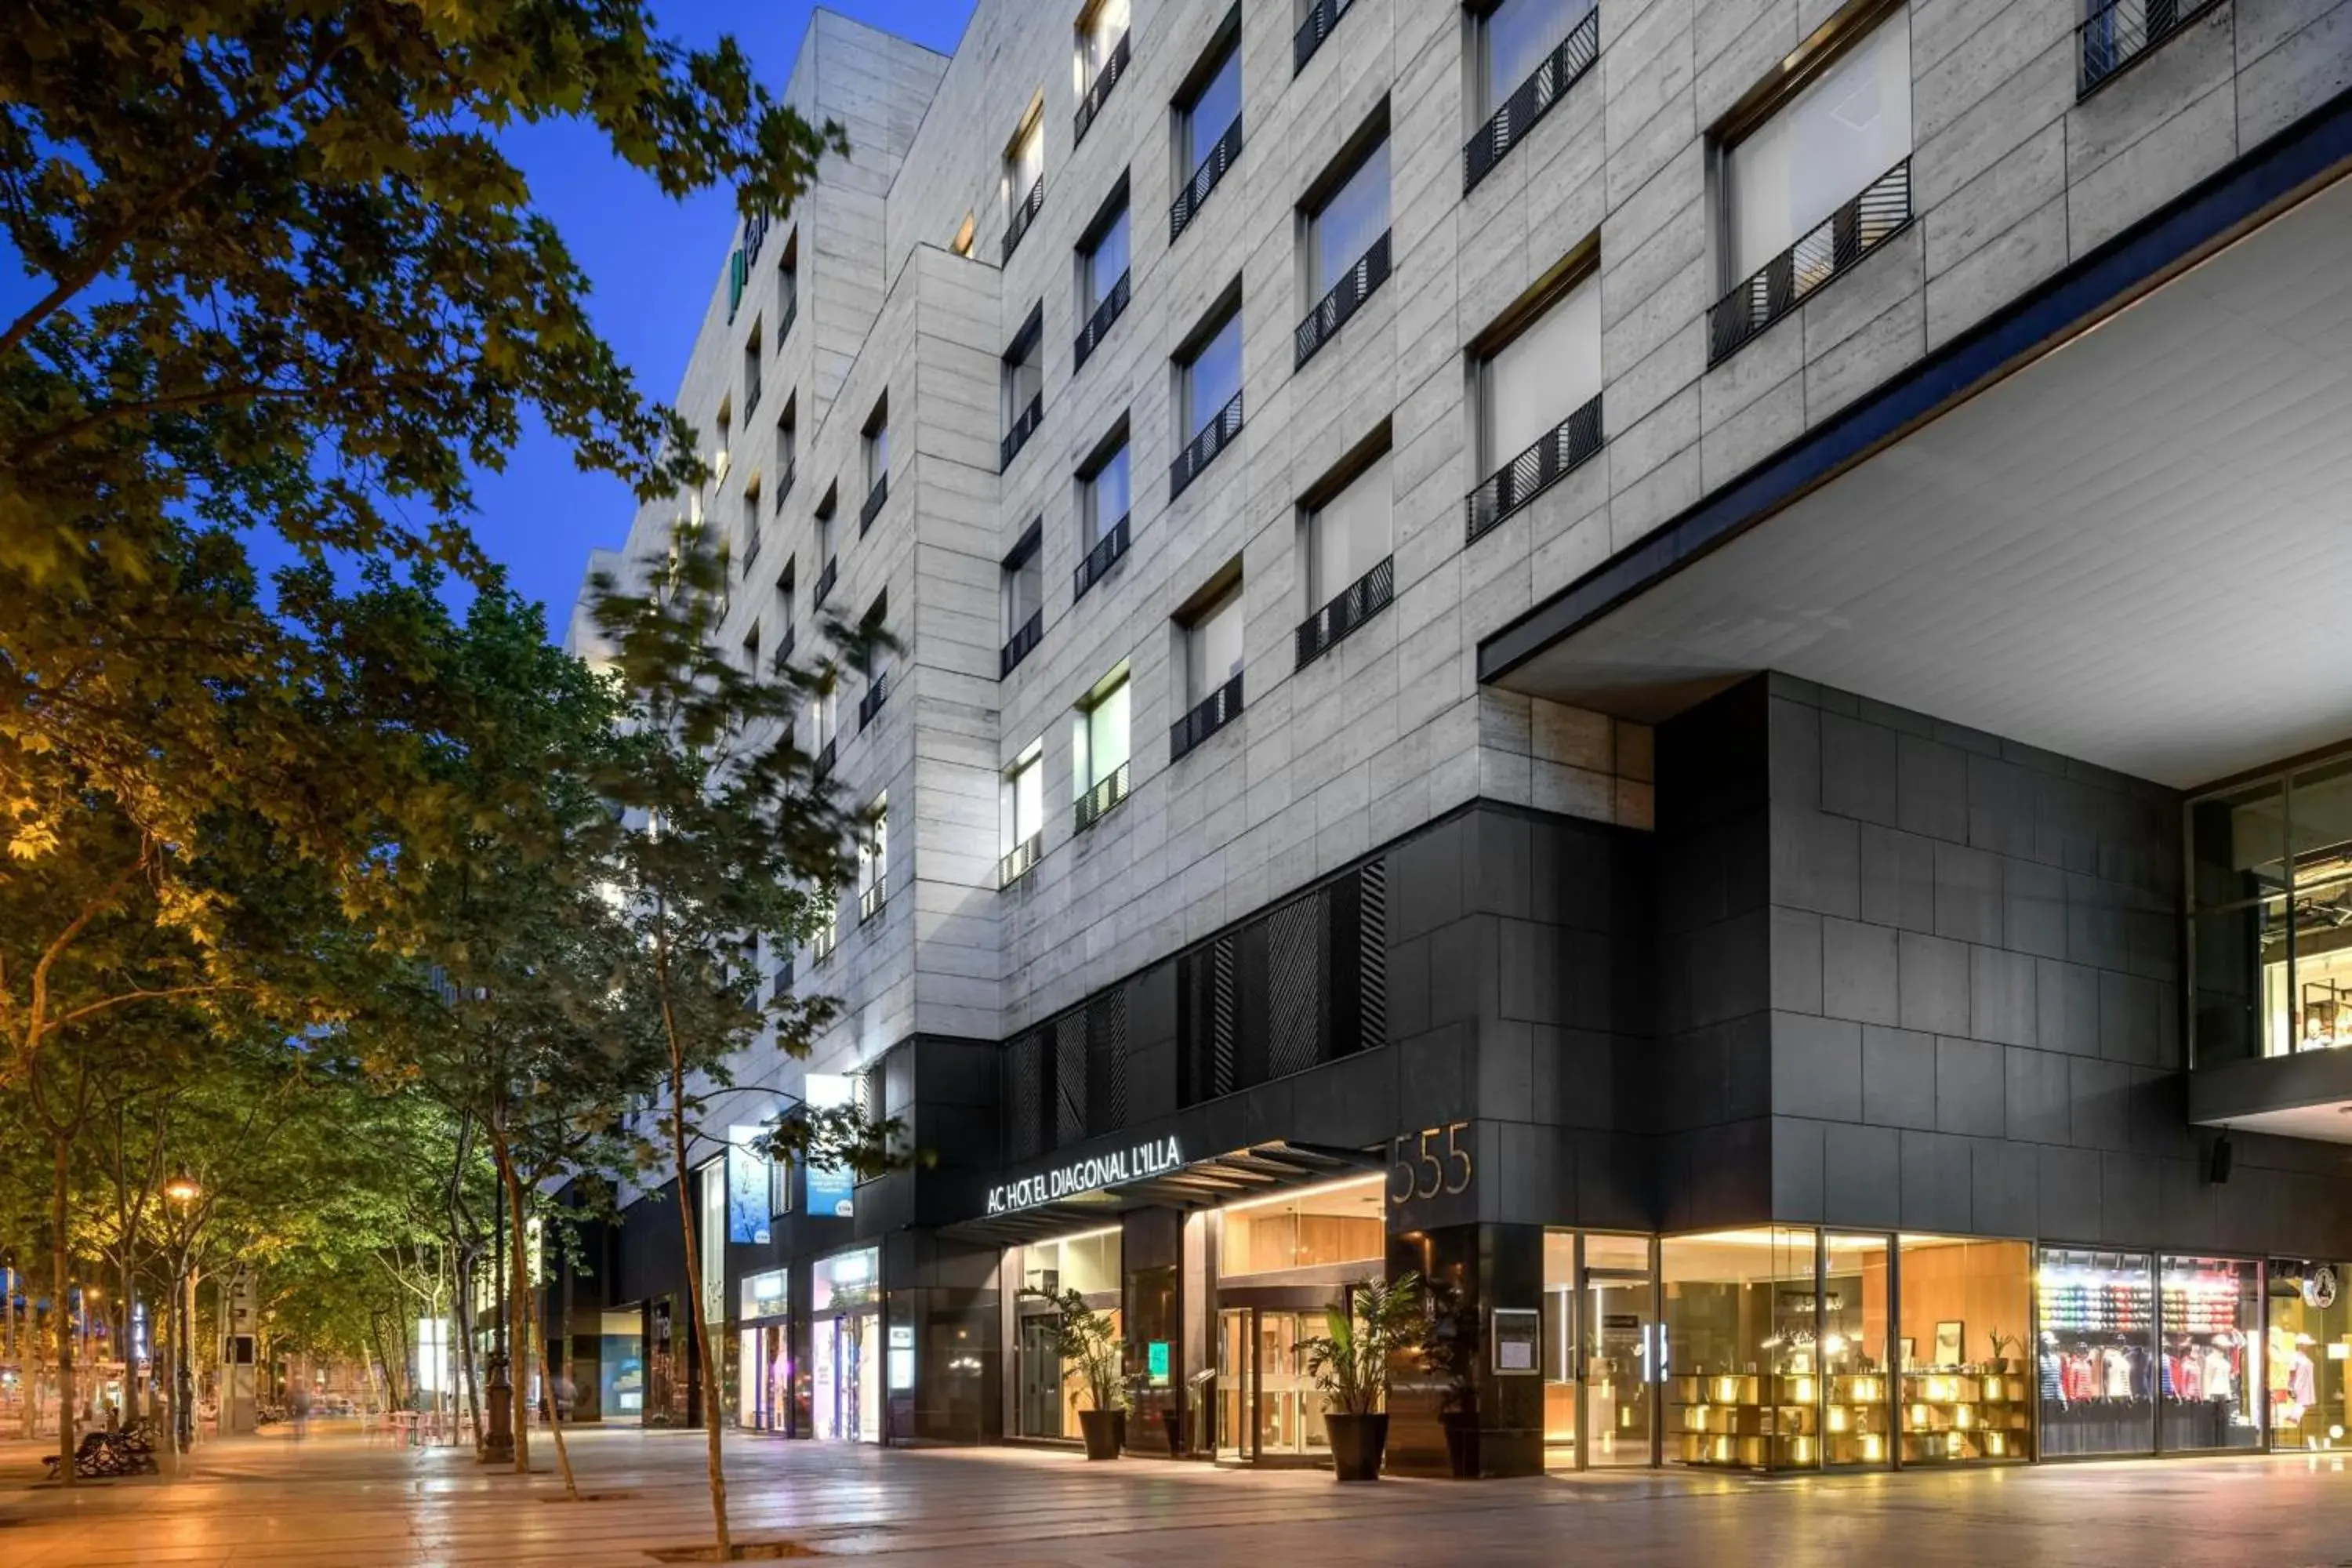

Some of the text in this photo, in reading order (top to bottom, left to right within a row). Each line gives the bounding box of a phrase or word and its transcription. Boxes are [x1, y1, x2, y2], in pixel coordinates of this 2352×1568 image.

[987, 1135, 1180, 1214] AC HOTEL DIAGONAL L'ILLA
[1392, 1122, 1471, 1203] 555
